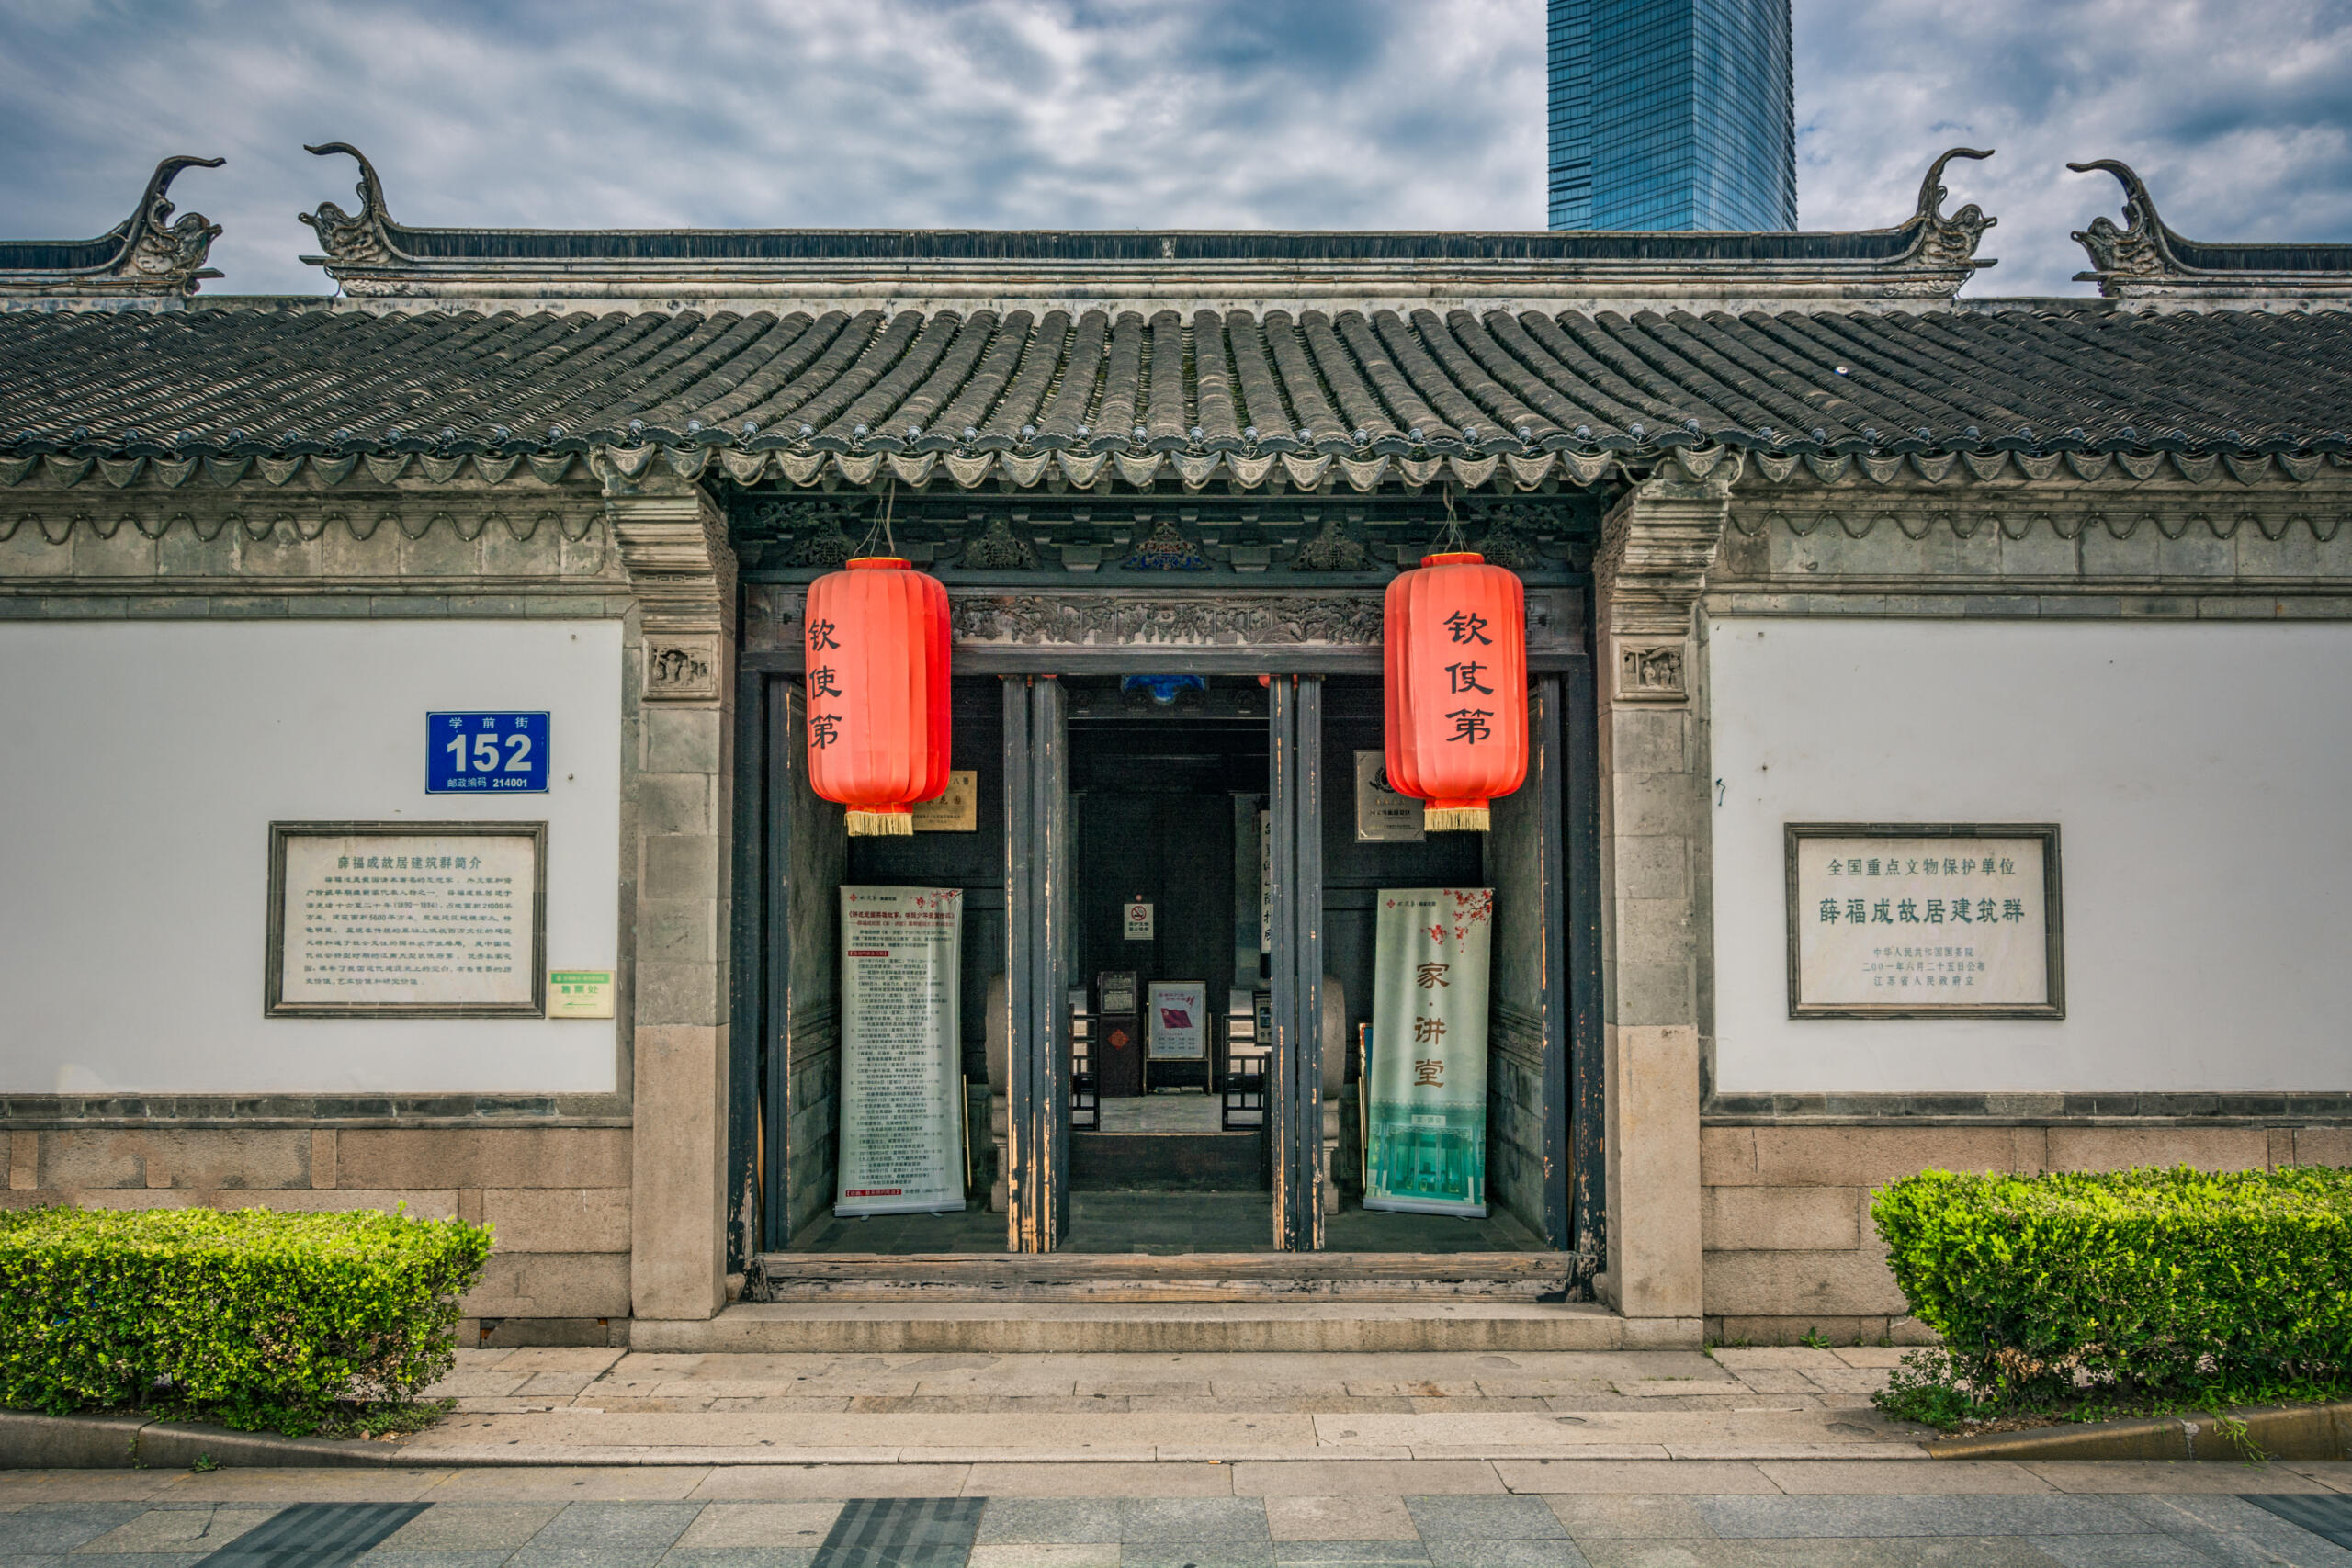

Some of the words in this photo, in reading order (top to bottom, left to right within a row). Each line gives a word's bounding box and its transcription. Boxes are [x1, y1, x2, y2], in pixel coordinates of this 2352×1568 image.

[808, 618, 842, 750] 钦使第
[1442, 609, 1494, 745] 钦使第
[448, 716, 529, 729] 学前街
[447, 733, 532, 773] 152
[447, 776, 487, 788] 邮政编码
[492, 778, 527, 788] 214001
[337, 855, 482, 870] 薛福成故居建筑群简介
[1827, 857, 2017, 876] 全国重点文物保护单位
[1818, 897, 2027, 926] 薛福成故居建筑群
[1872, 946, 1974, 958] 中华人民共和国国务院
[1873, 975, 1976, 987] 江苏省人民政府立
